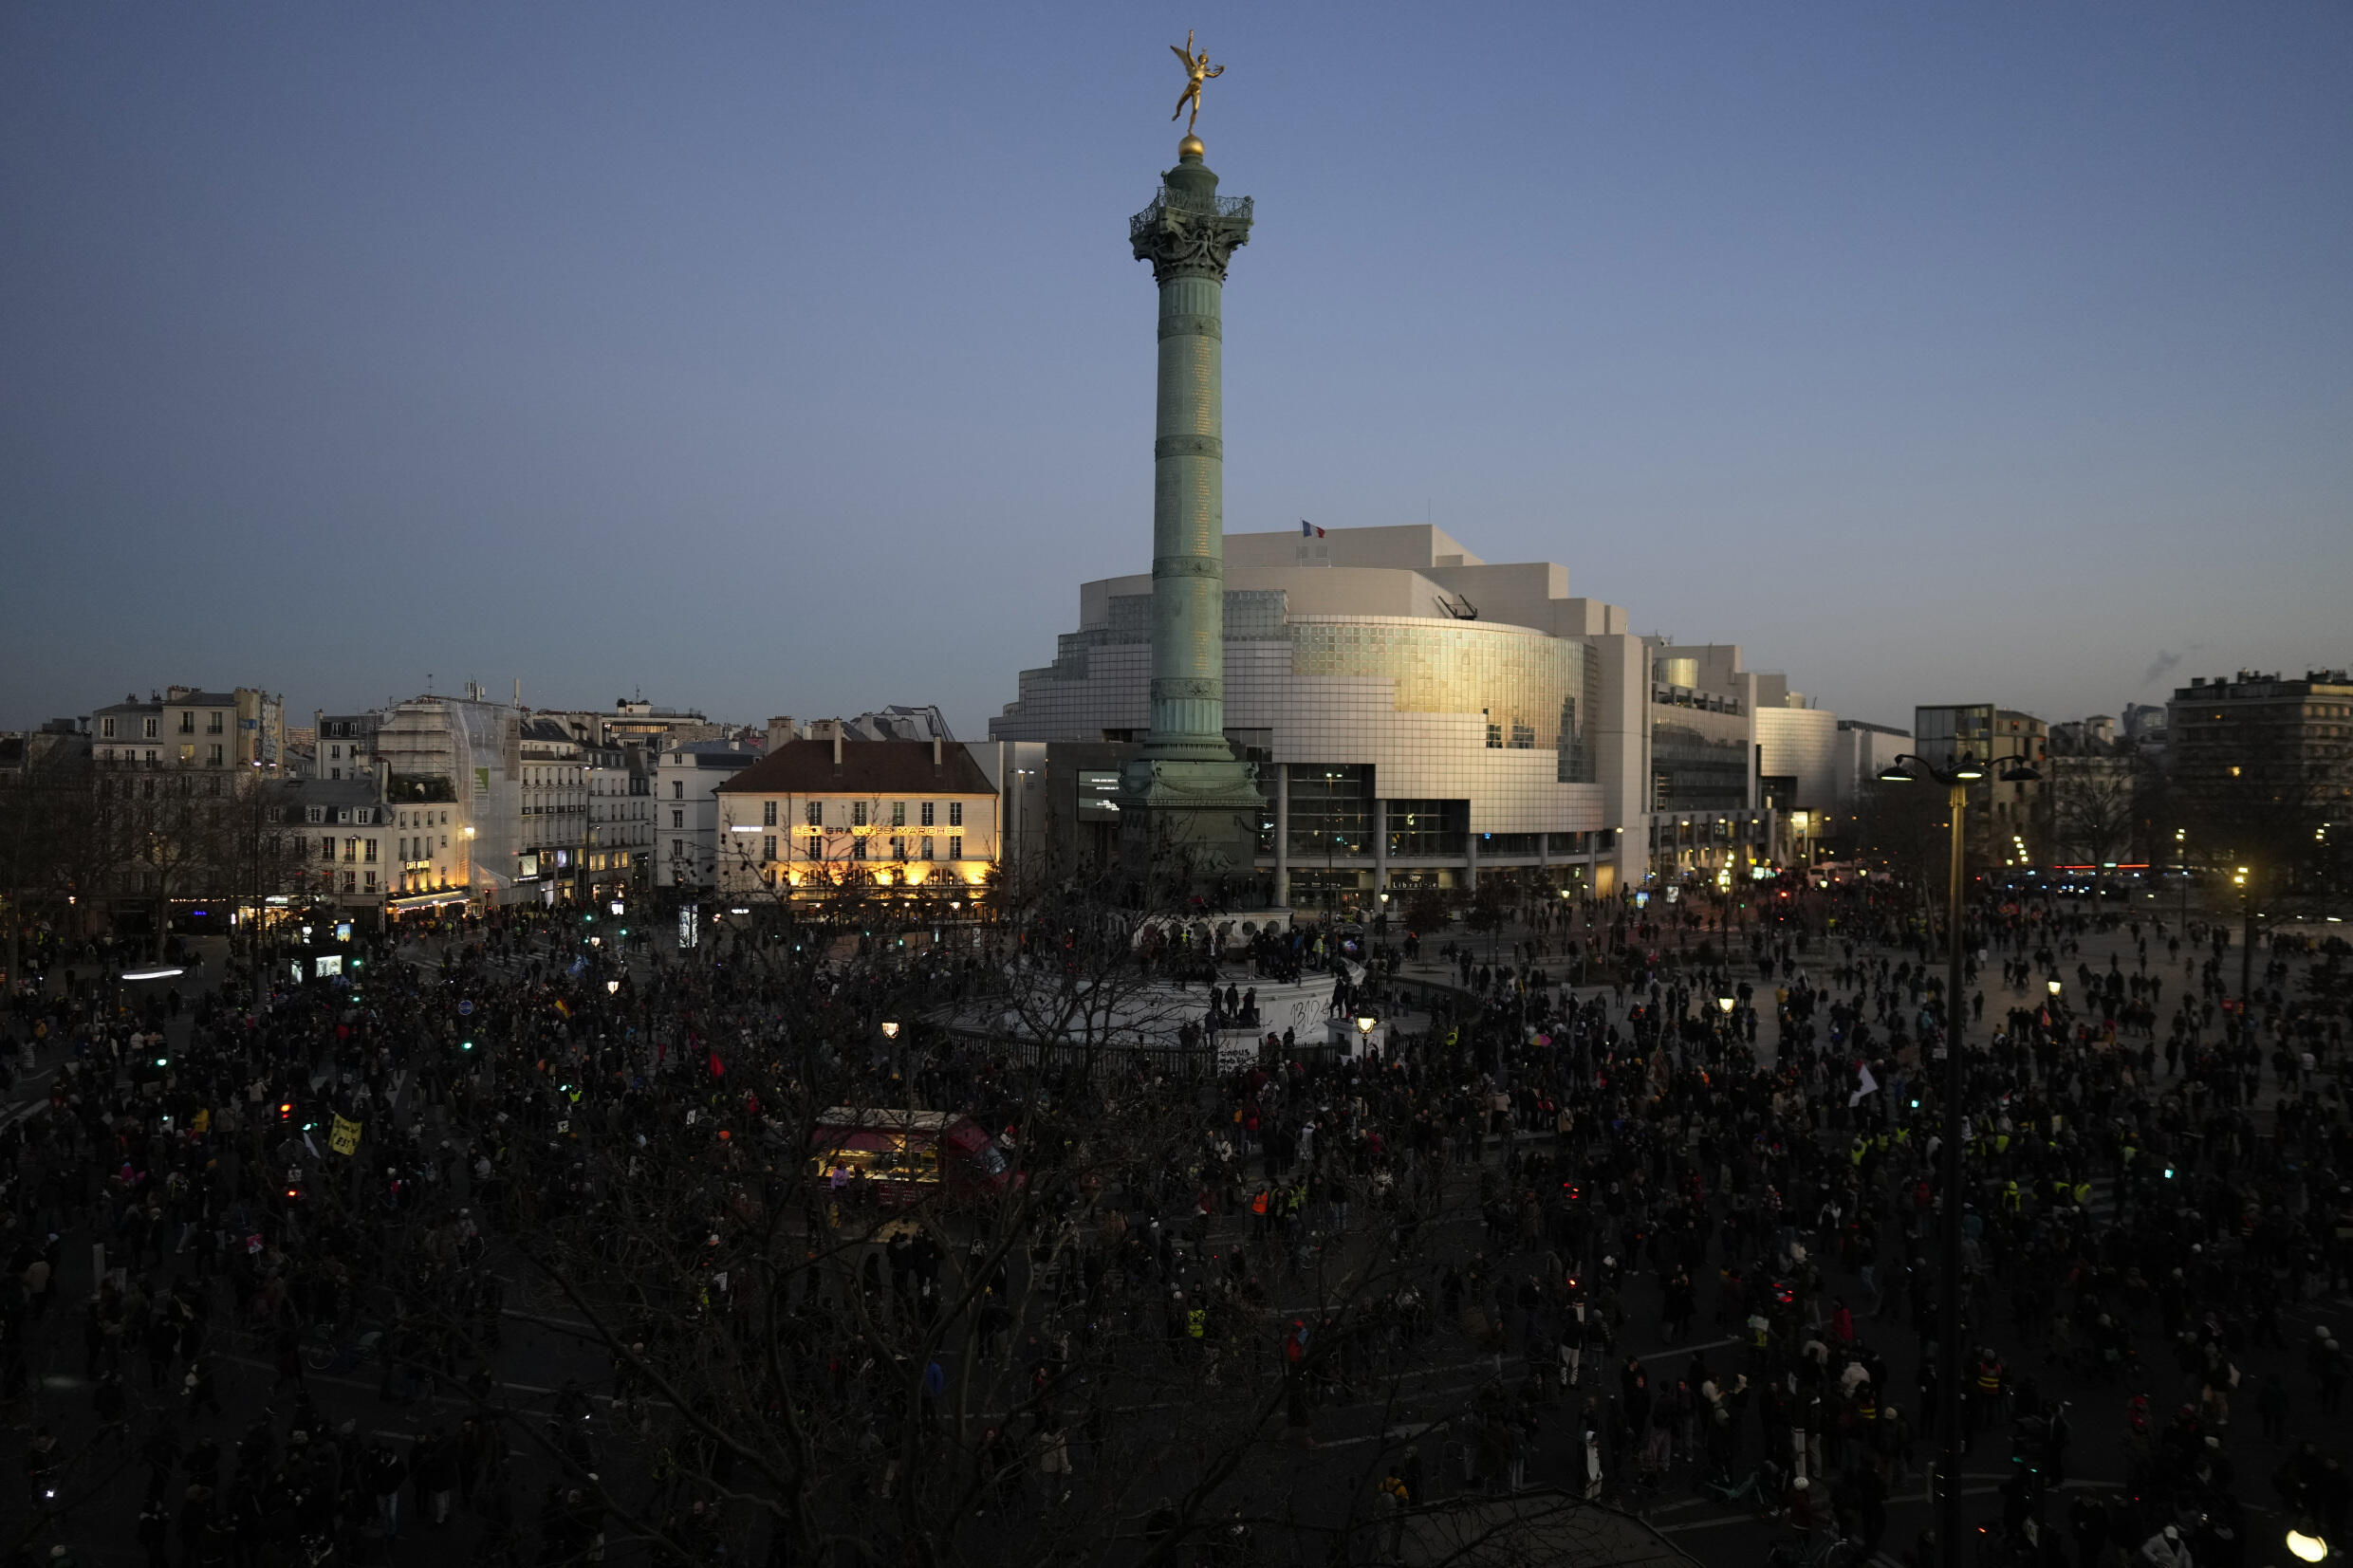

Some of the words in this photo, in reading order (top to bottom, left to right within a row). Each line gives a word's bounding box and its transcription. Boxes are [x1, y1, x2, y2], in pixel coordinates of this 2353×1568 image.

[794, 826, 820, 835] LES
[825, 826, 892, 835] GRANDES
[898, 826, 963, 835] MARCHES
[1290, 1000, 1320, 1028] 1312
